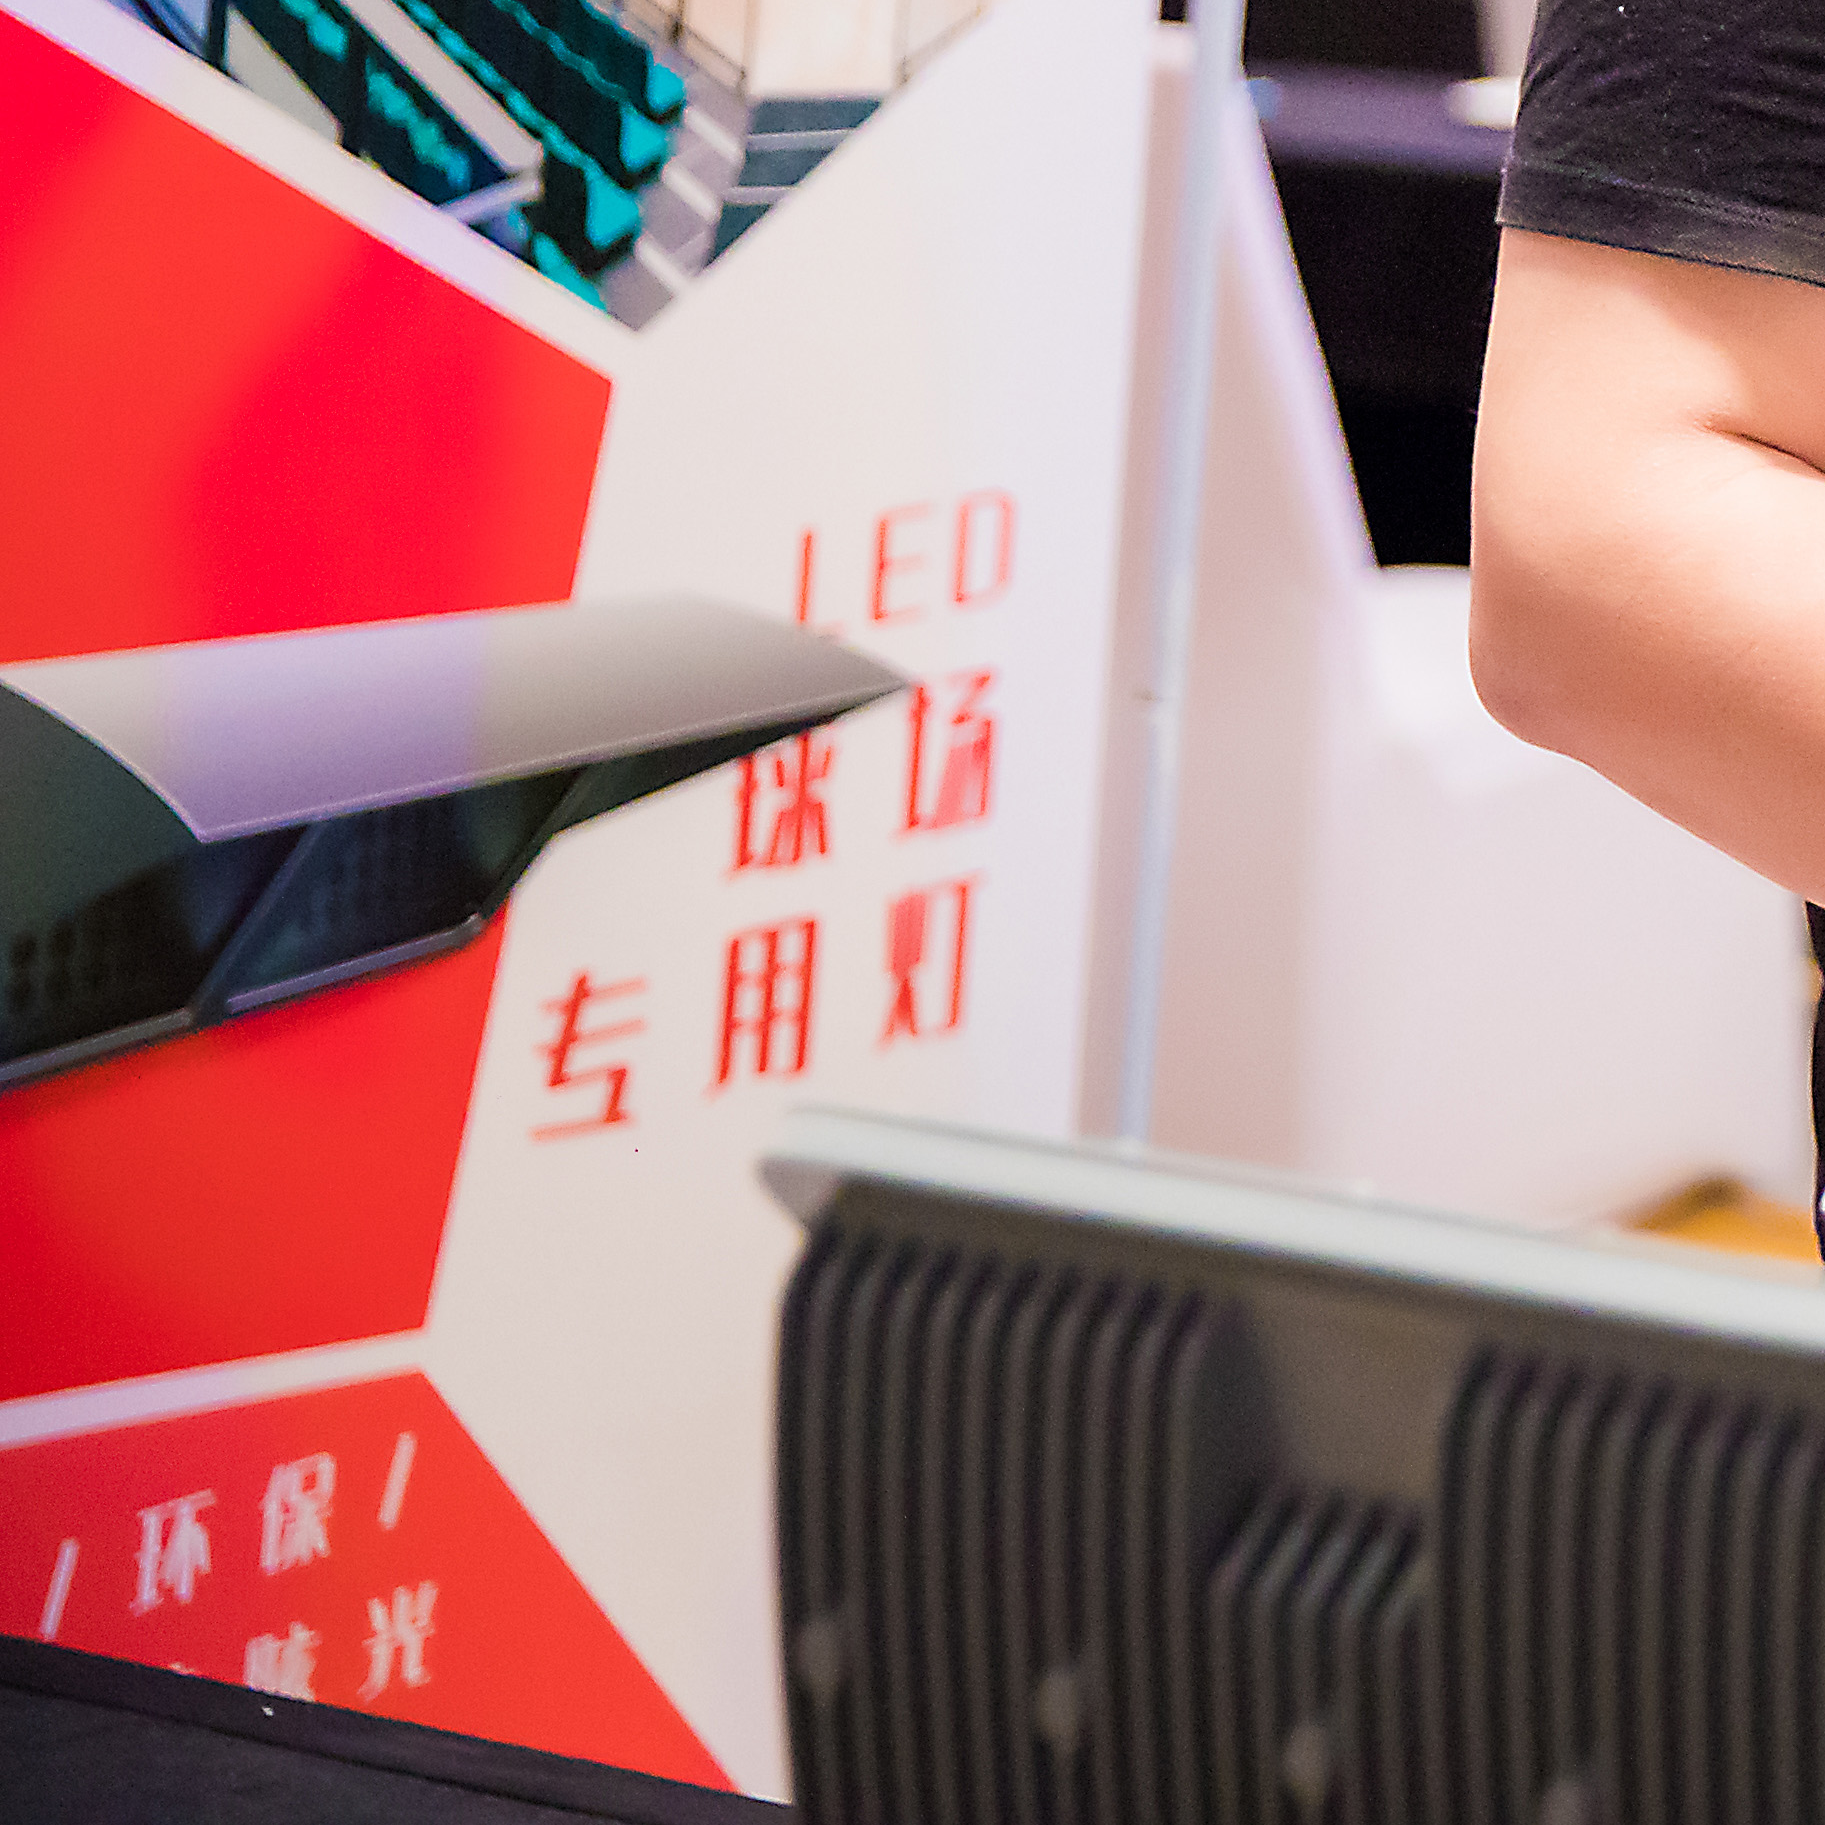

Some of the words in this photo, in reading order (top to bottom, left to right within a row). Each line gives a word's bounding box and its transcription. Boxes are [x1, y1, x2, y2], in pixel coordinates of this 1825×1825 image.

[797, 490, 1014, 641] LED
[728, 669, 997, 874] 球场
[530, 874, 984, 1142] 专用灯
